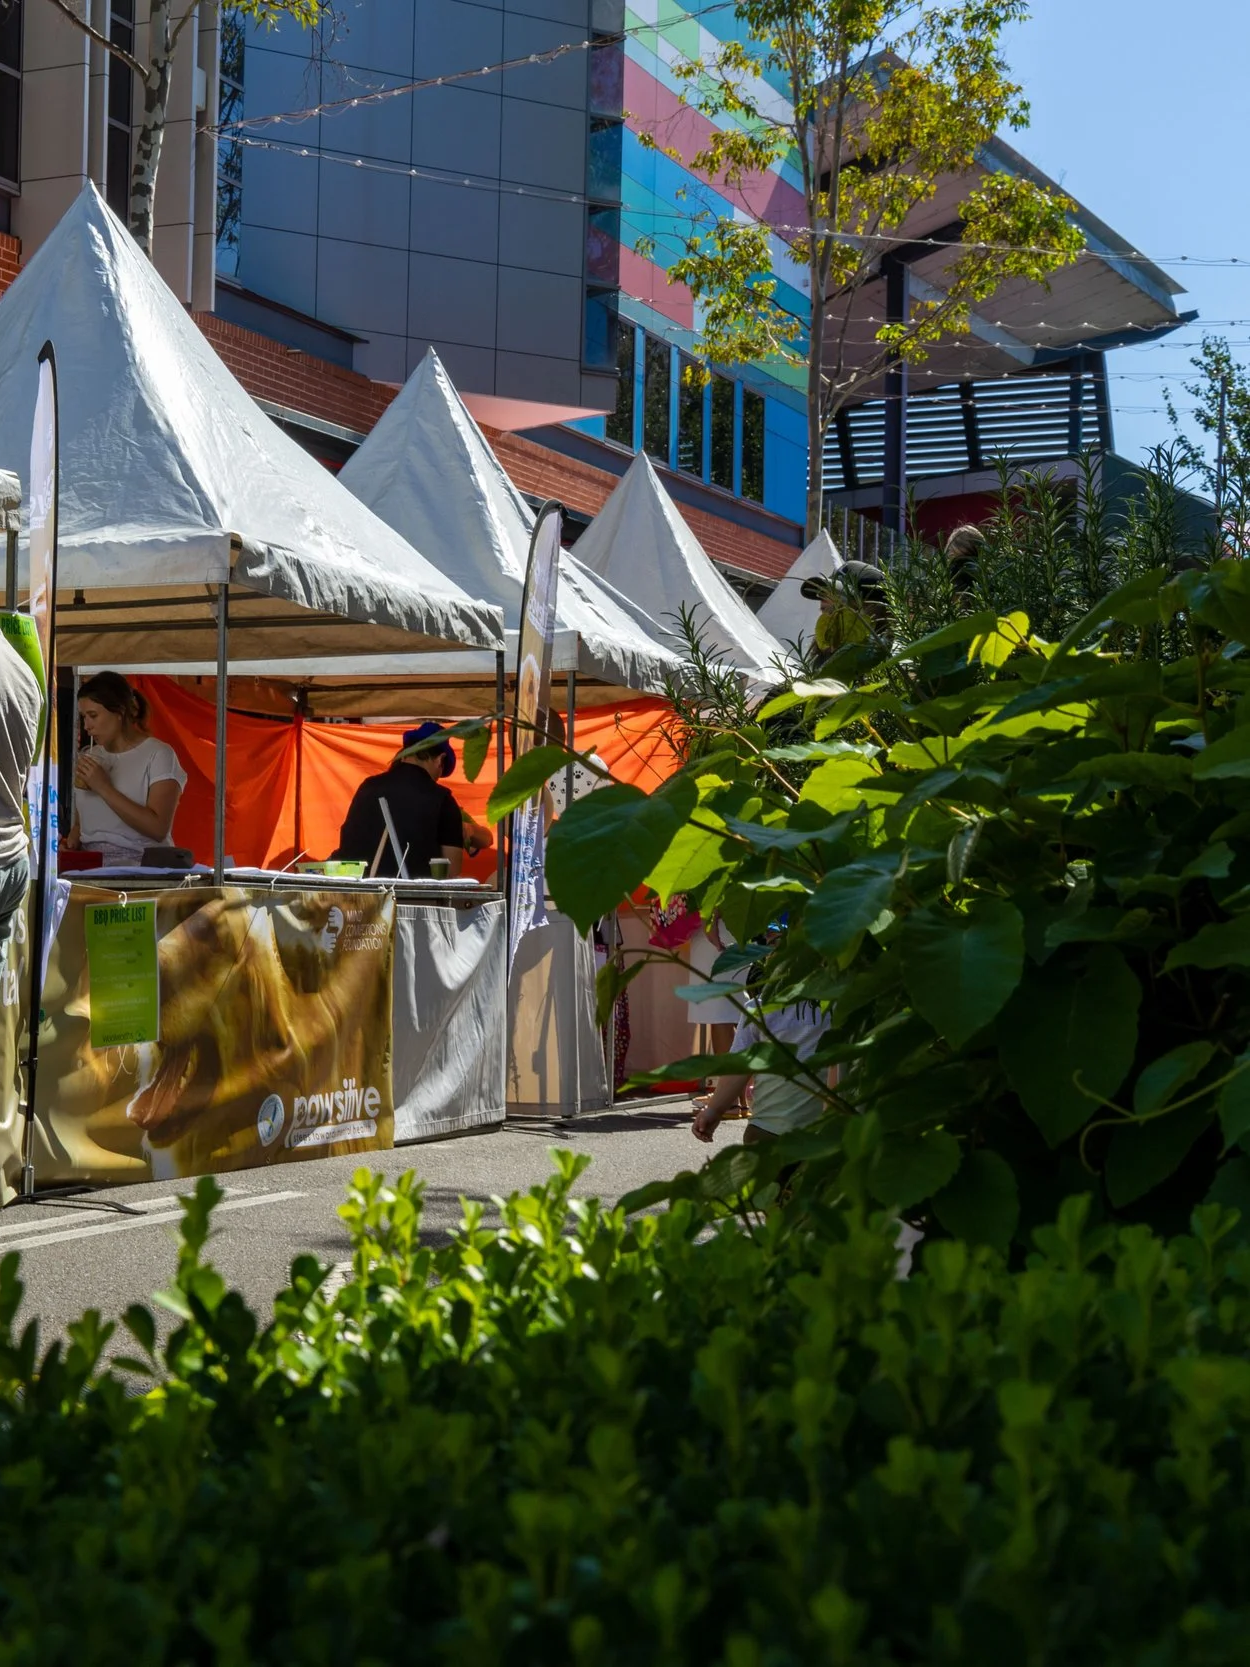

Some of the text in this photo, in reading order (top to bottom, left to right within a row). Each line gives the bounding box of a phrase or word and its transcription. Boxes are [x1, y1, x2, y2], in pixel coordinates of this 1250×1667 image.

[93, 906, 147, 926] BBQ PRICE LIST
[285, 1077, 381, 1147] pawsitive
